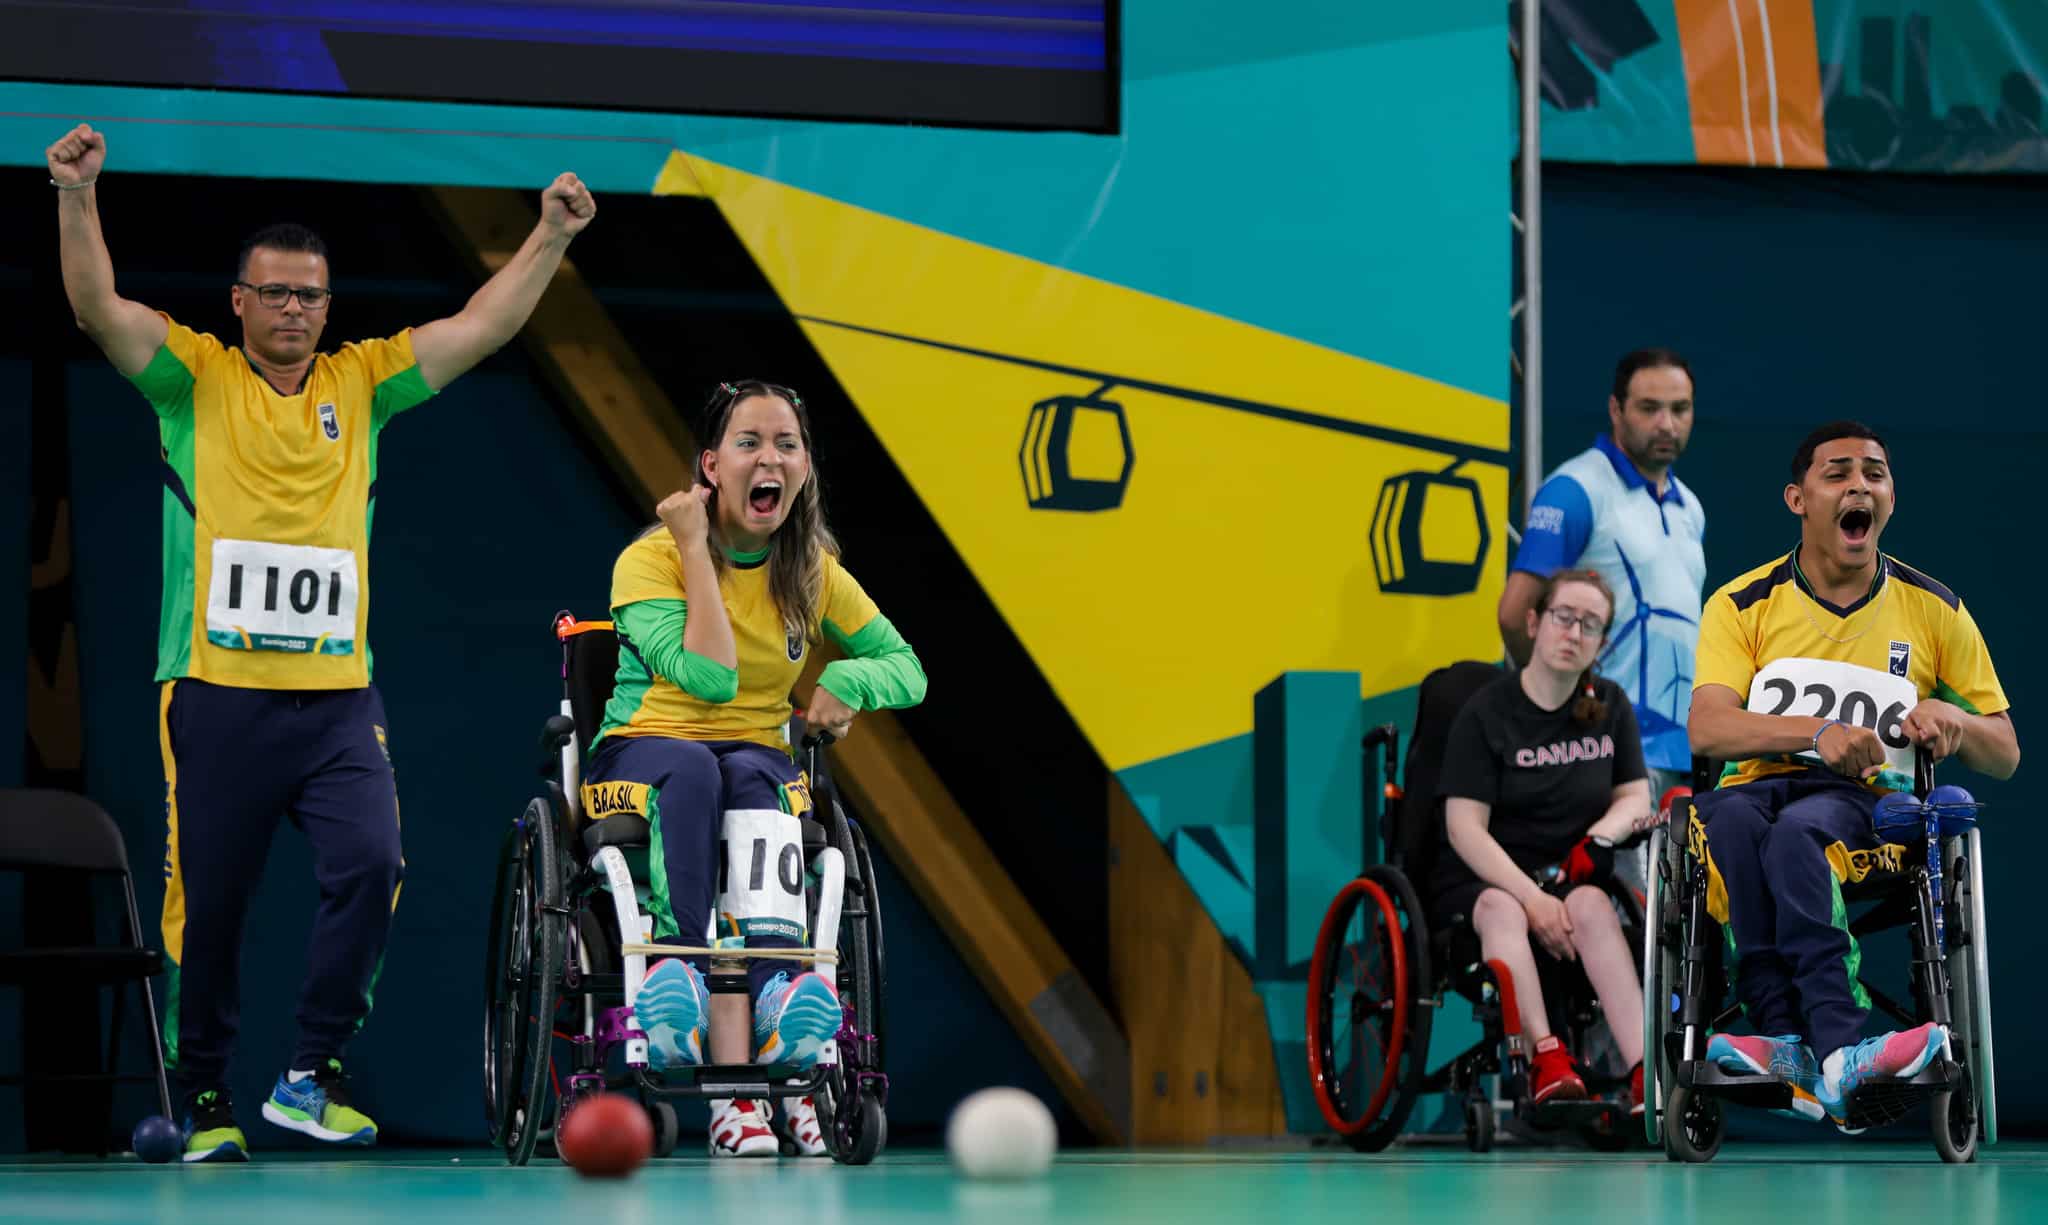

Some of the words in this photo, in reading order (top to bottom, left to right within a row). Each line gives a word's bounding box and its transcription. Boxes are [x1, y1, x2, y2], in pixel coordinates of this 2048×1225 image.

[229, 564, 341, 616] 1101
[1763, 678, 1910, 749] 2206
[1516, 734, 1614, 767] CANADA
[593, 784, 638, 814] BRASIL
